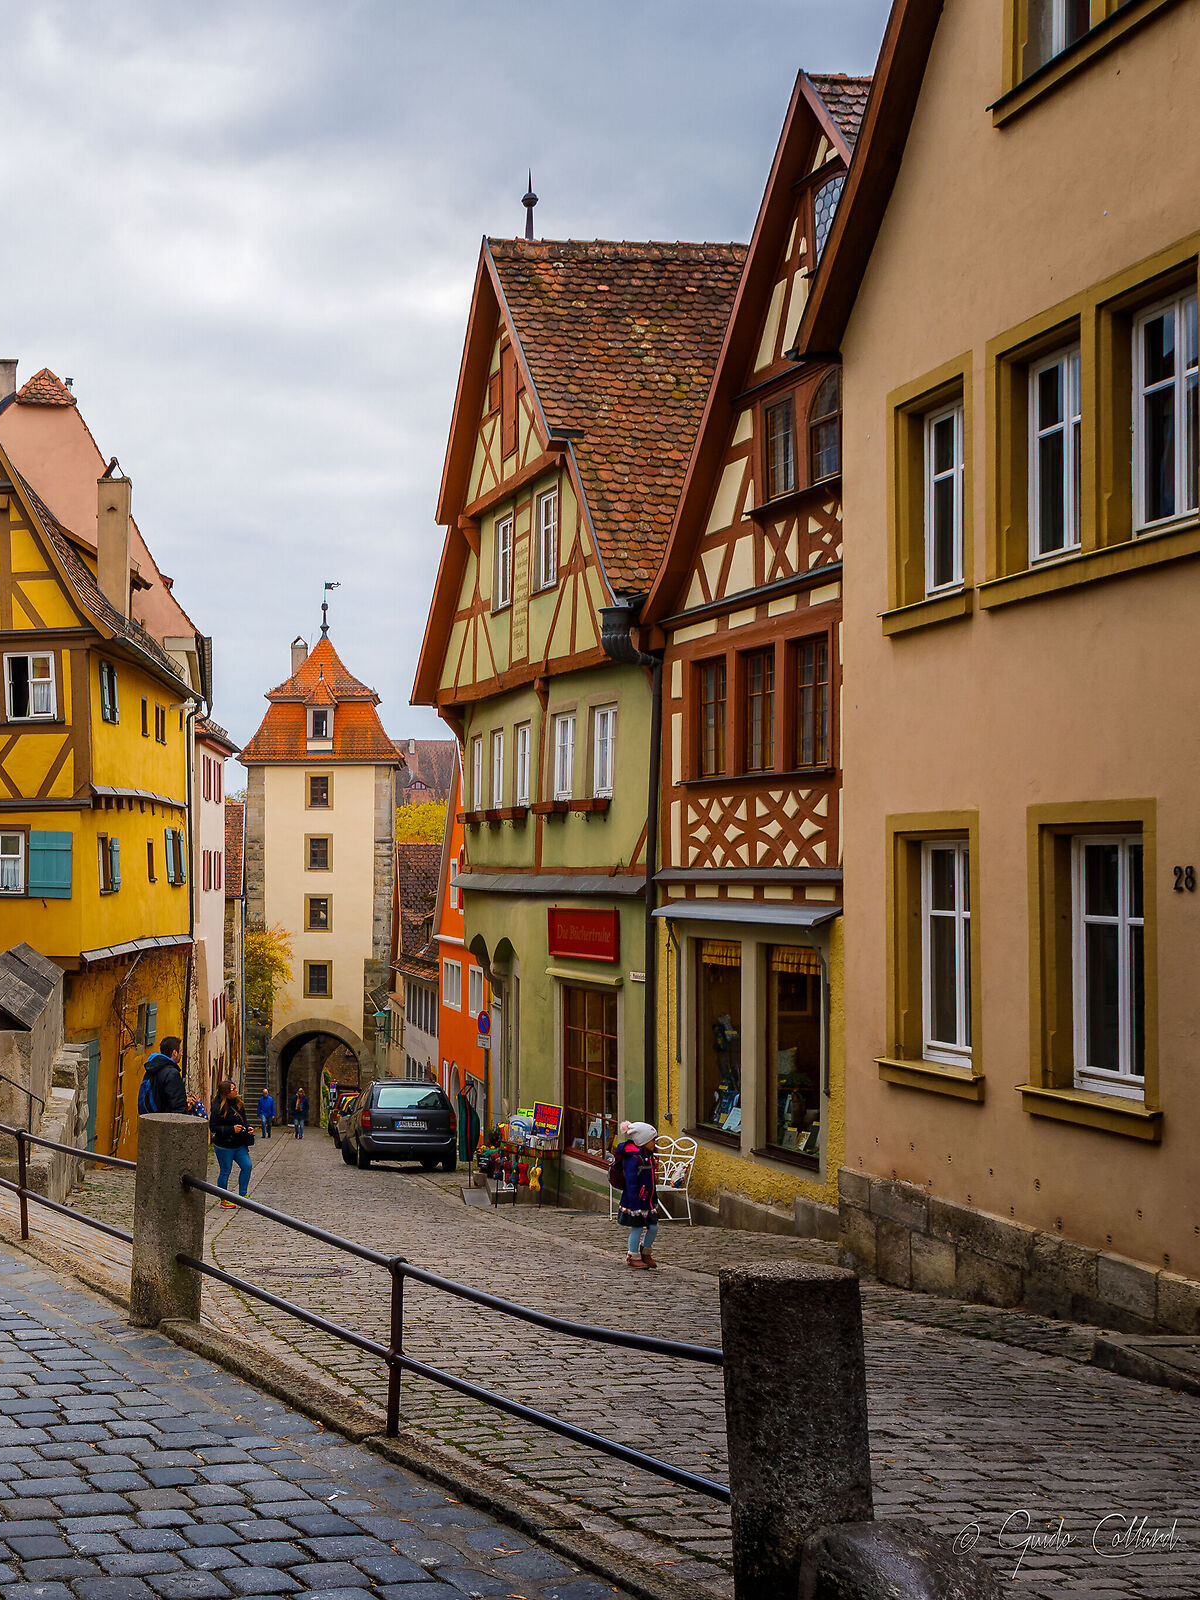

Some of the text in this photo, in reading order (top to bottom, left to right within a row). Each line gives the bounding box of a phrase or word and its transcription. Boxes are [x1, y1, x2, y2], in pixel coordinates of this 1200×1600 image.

[1173, 865, 1196, 893] 28
[557, 924, 611, 943] Die Büchertruhe
[537, 1105, 560, 1117] STARKE
